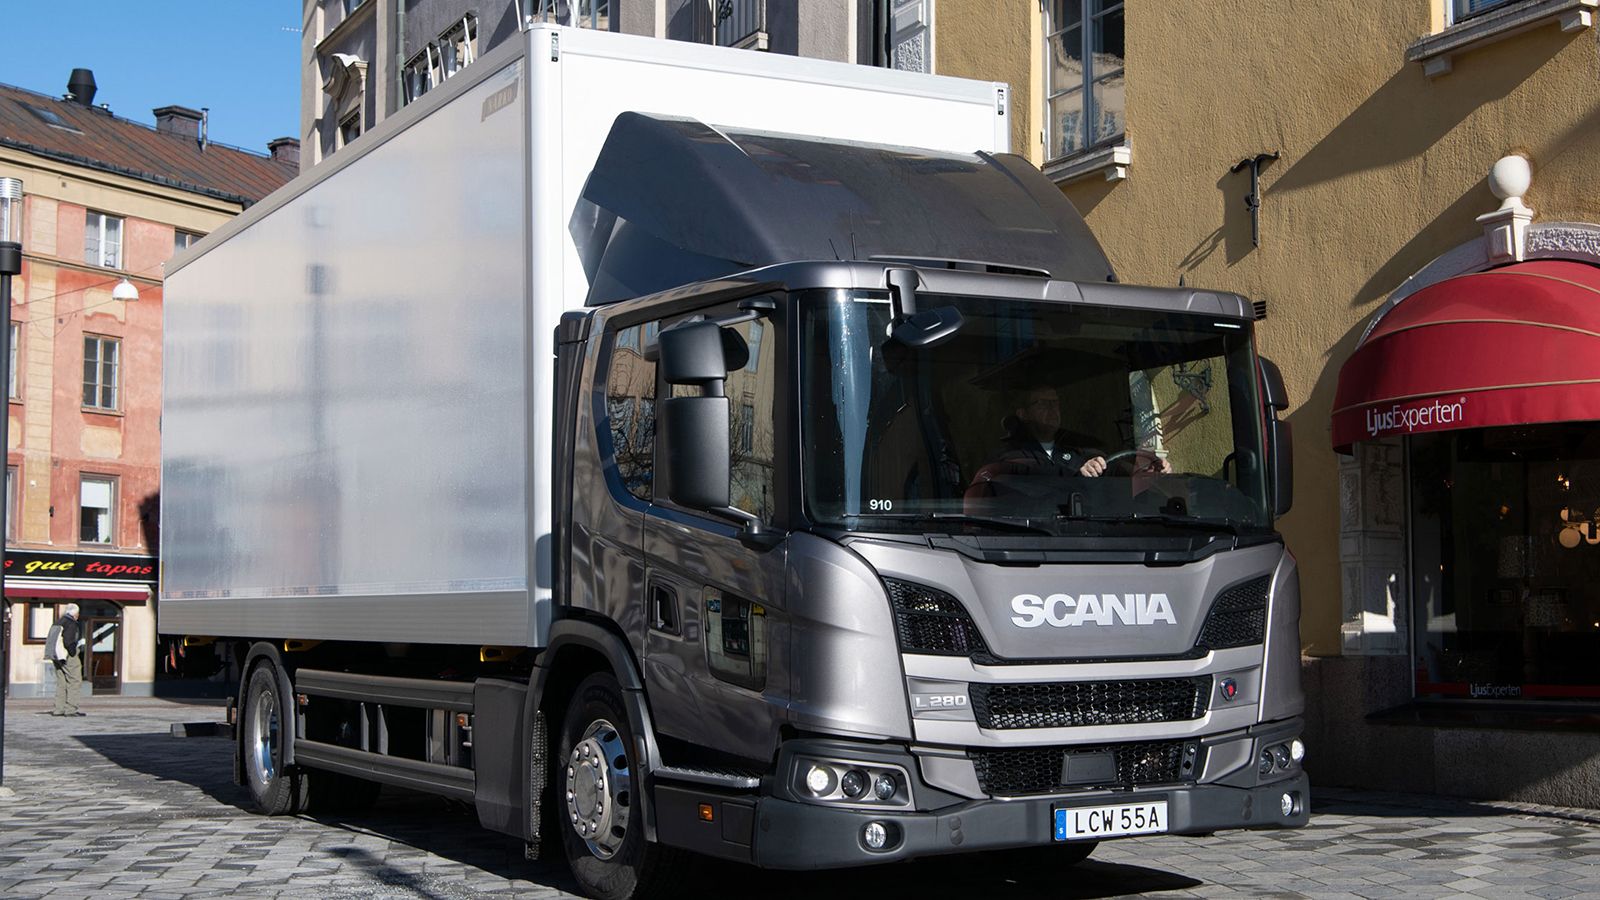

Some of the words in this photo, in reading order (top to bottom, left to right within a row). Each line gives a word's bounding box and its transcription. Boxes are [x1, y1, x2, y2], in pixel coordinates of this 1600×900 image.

[869, 499, 893, 511] 910
[24, 560, 75, 573] que
[85, 561, 153, 576] tapas
[1010, 593, 1178, 628] SCANIA
[1470, 682, 1521, 698] LjusExperten
[915, 696, 927, 708] L
[930, 695, 967, 707] 280
[1075, 811, 1114, 834] LCW
[1121, 806, 1159, 830] 55A
